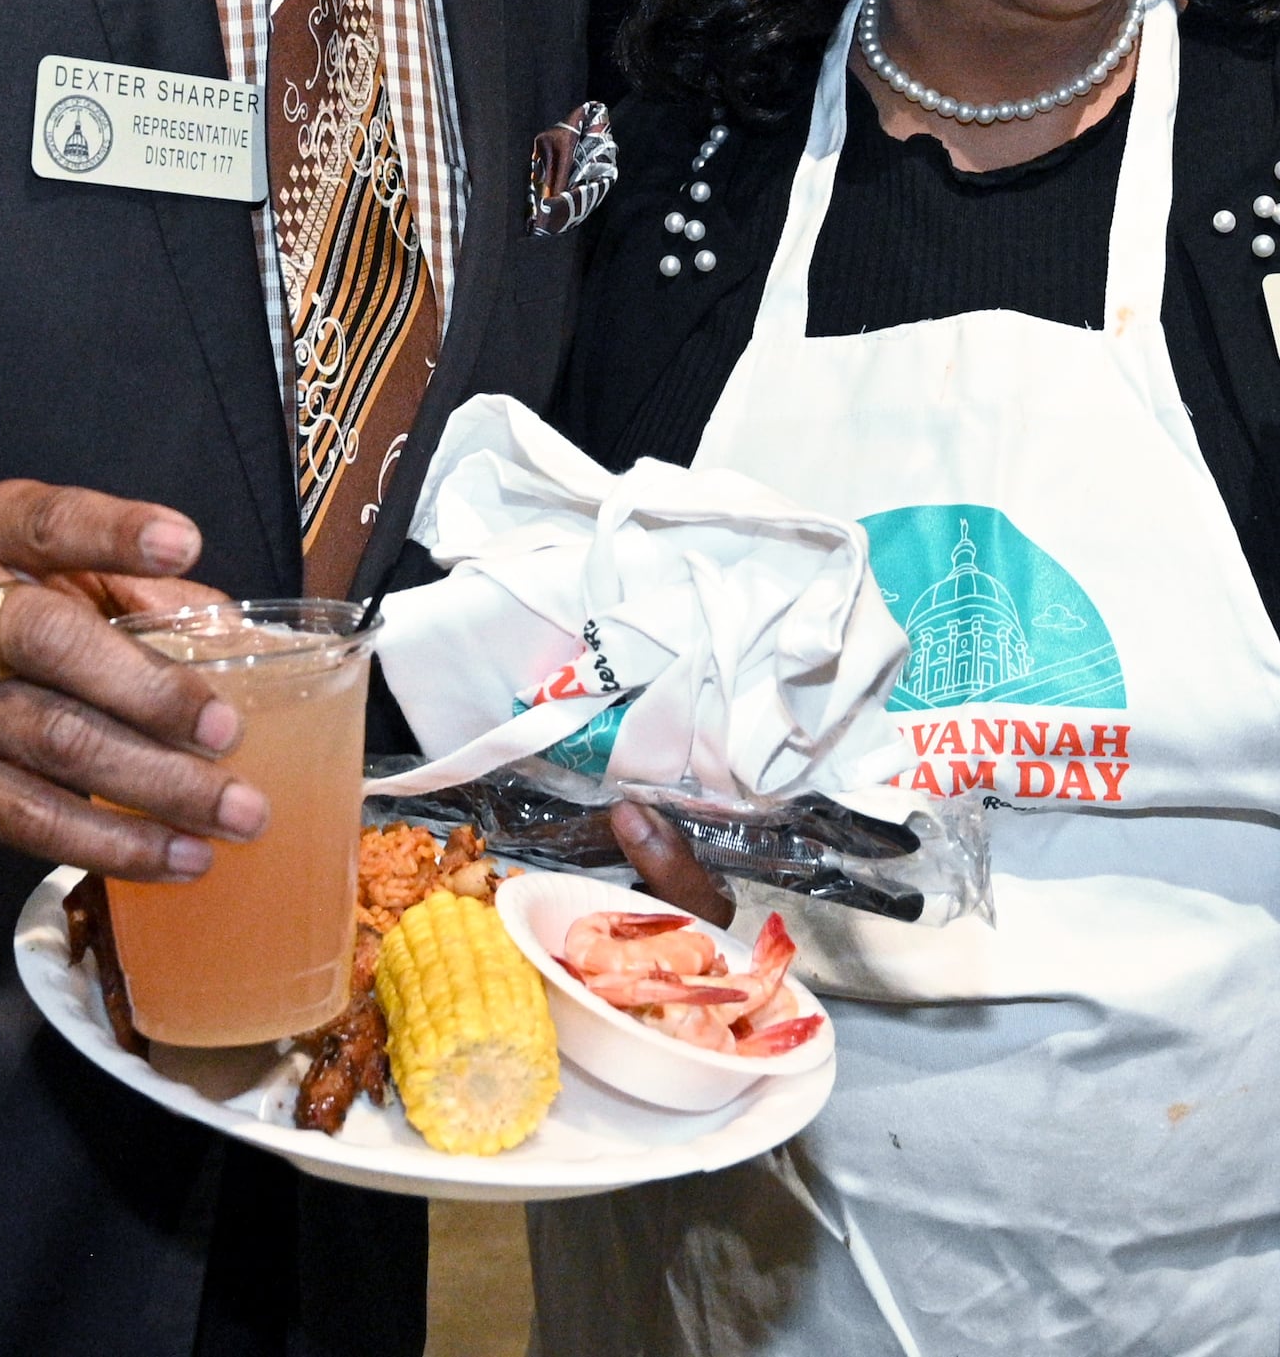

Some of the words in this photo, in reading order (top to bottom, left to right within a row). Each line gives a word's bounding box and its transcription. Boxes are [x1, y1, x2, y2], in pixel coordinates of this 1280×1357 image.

[55, 65, 146, 98] DEXTER
[157, 80, 260, 115] SHARPER
[132, 115, 249, 148] REPRESENTATIVE
[145, 145, 207, 172] DISTRICT
[212, 155, 233, 174] 177
[898, 718, 1131, 758] VANNAH
[889, 760, 997, 800] AM
[1014, 760, 1131, 801] DAY
